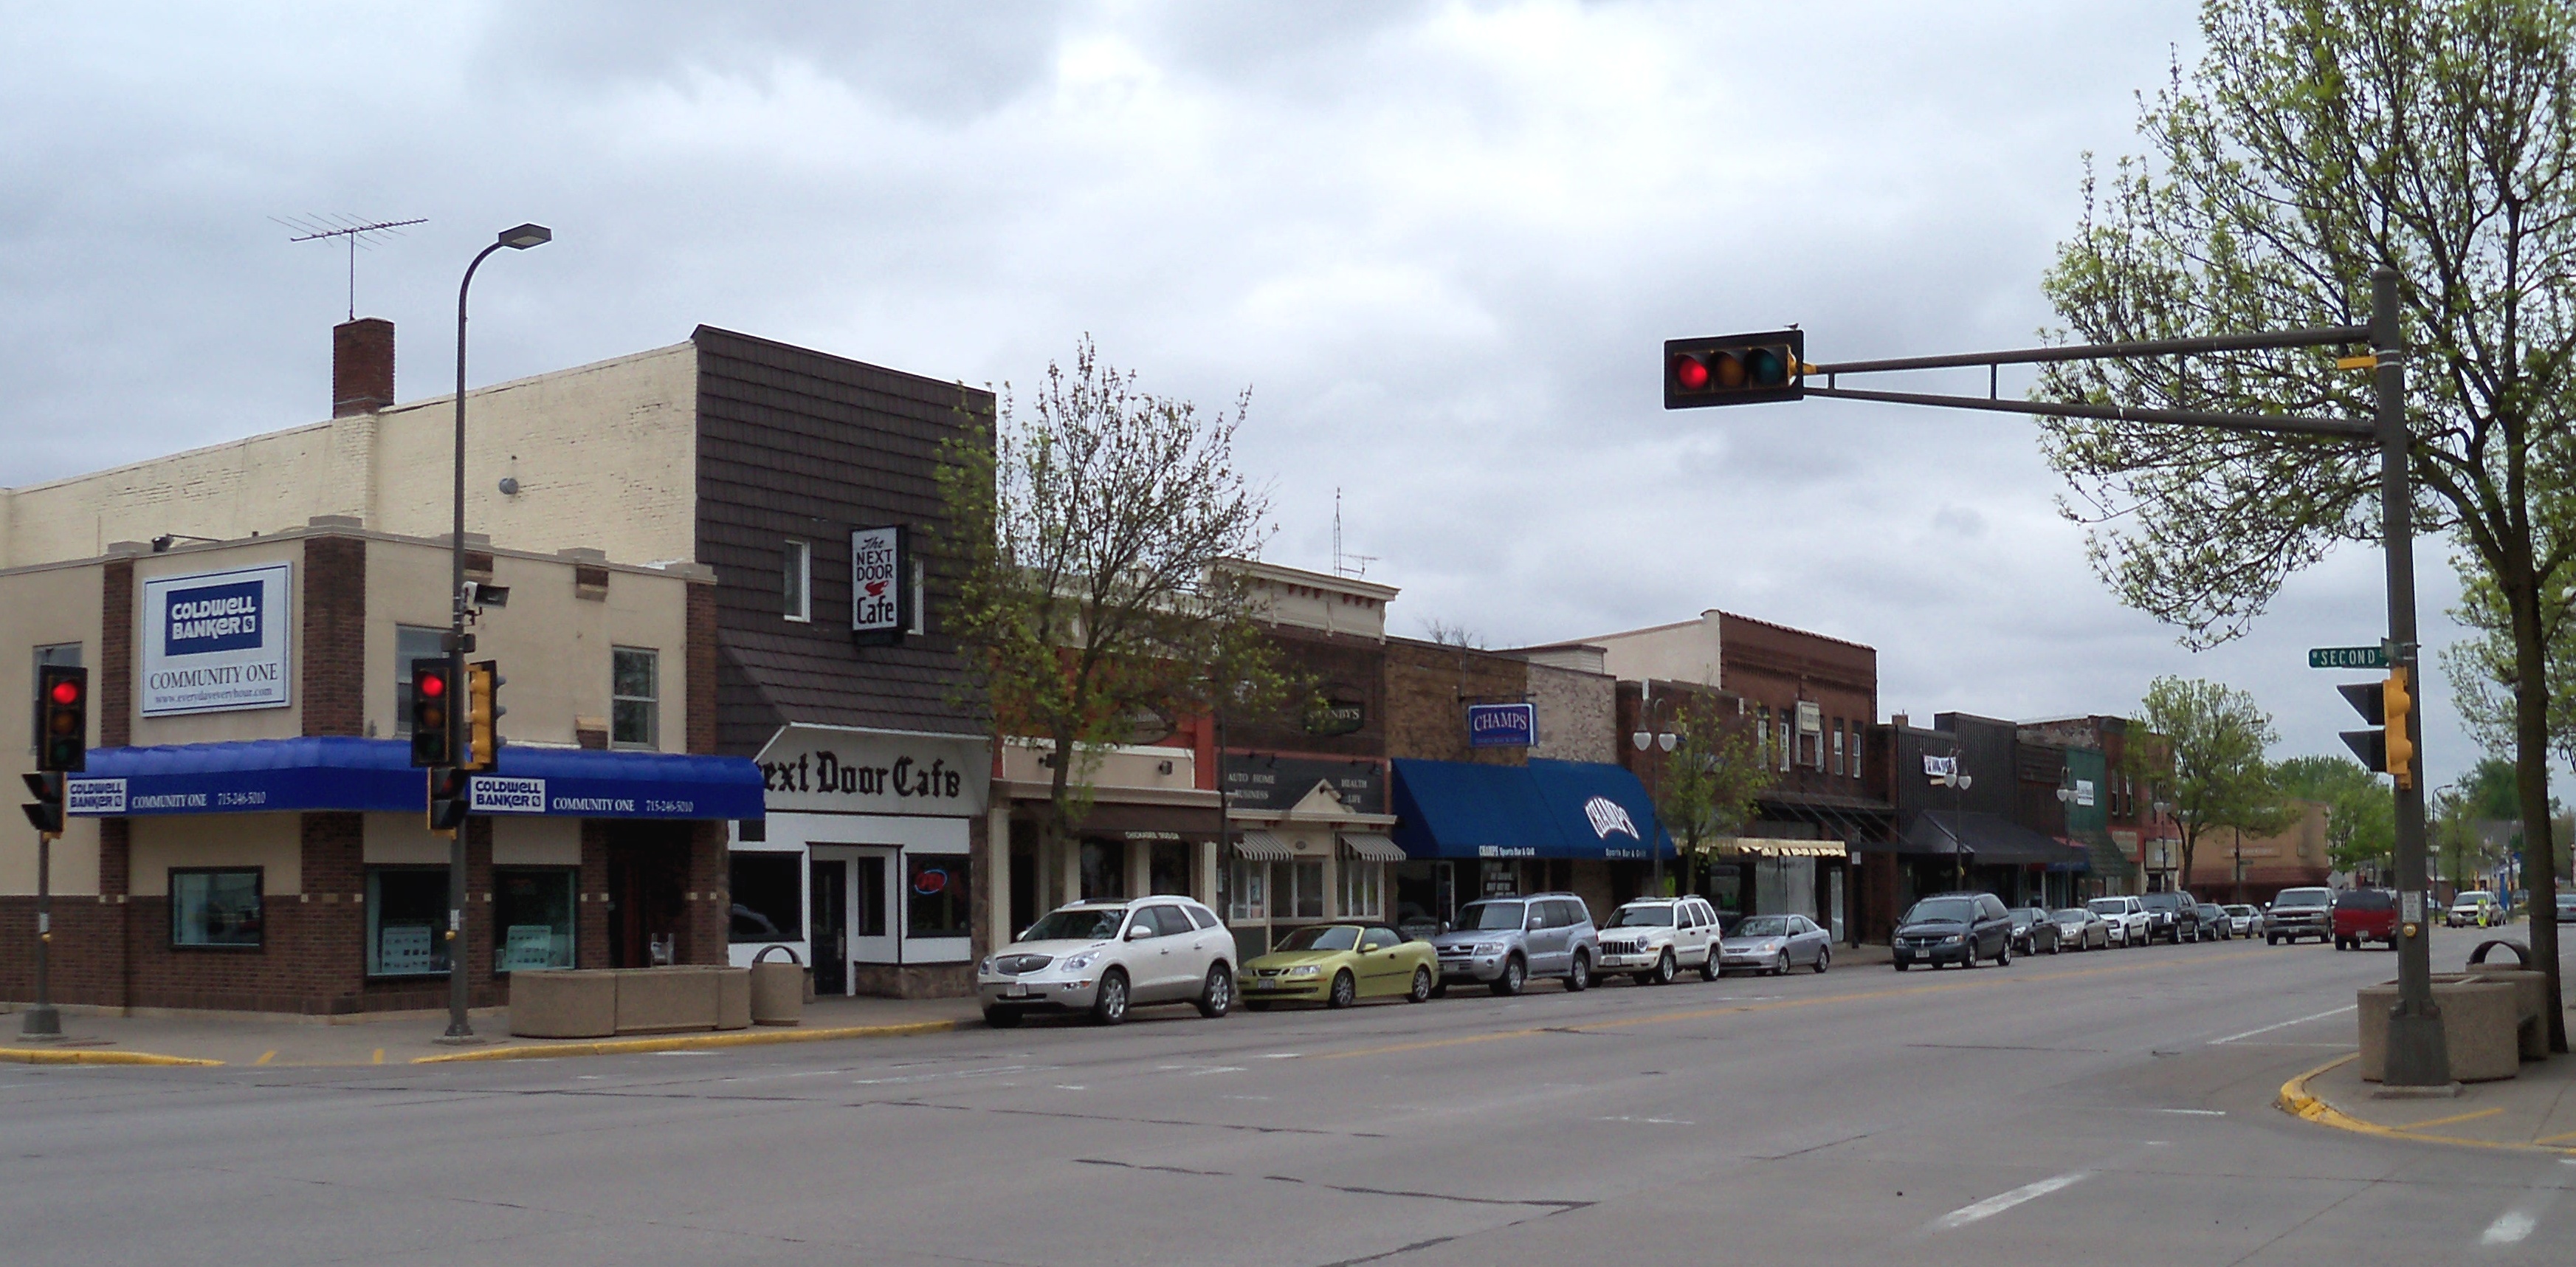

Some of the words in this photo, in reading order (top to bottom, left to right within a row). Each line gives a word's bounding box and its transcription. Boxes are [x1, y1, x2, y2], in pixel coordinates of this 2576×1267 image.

[861, 536, 884, 550] The
[856, 549, 893, 566] NEXT
[856, 563, 893, 581] DOOR
[171, 595, 257, 620] COLDWELL
[856, 595, 894, 625] Cafe
[172, 616, 241, 640] BANKER
[2320, 649, 2376, 666] SECOND
[150, 665, 243, 690] COMMUNITY
[247, 662, 278, 682] ONE
[1474, 712, 1527, 732] CHAMPS
[757, 752, 810, 793] ext
[816, 750, 889, 795] Door
[1227, 772, 1249, 783] AUTO
[1253, 773, 1275, 785] HOME
[69, 782, 123, 795] COLDWELL
[475, 780, 542, 794] COLDWELL
[1340, 778, 1368, 789] HEALTH
[69, 794, 112, 809] BANKER
[131, 793, 187, 809] COMMUNITY
[187, 792, 207, 807] ONE
[476, 793, 530, 808] BANKER
[552, 796, 613, 811] COMMUNITY
[614, 797, 635, 812] ONE
[1348, 793, 1362, 804] LIFE
[1584, 797, 1640, 840] CHAMPS
